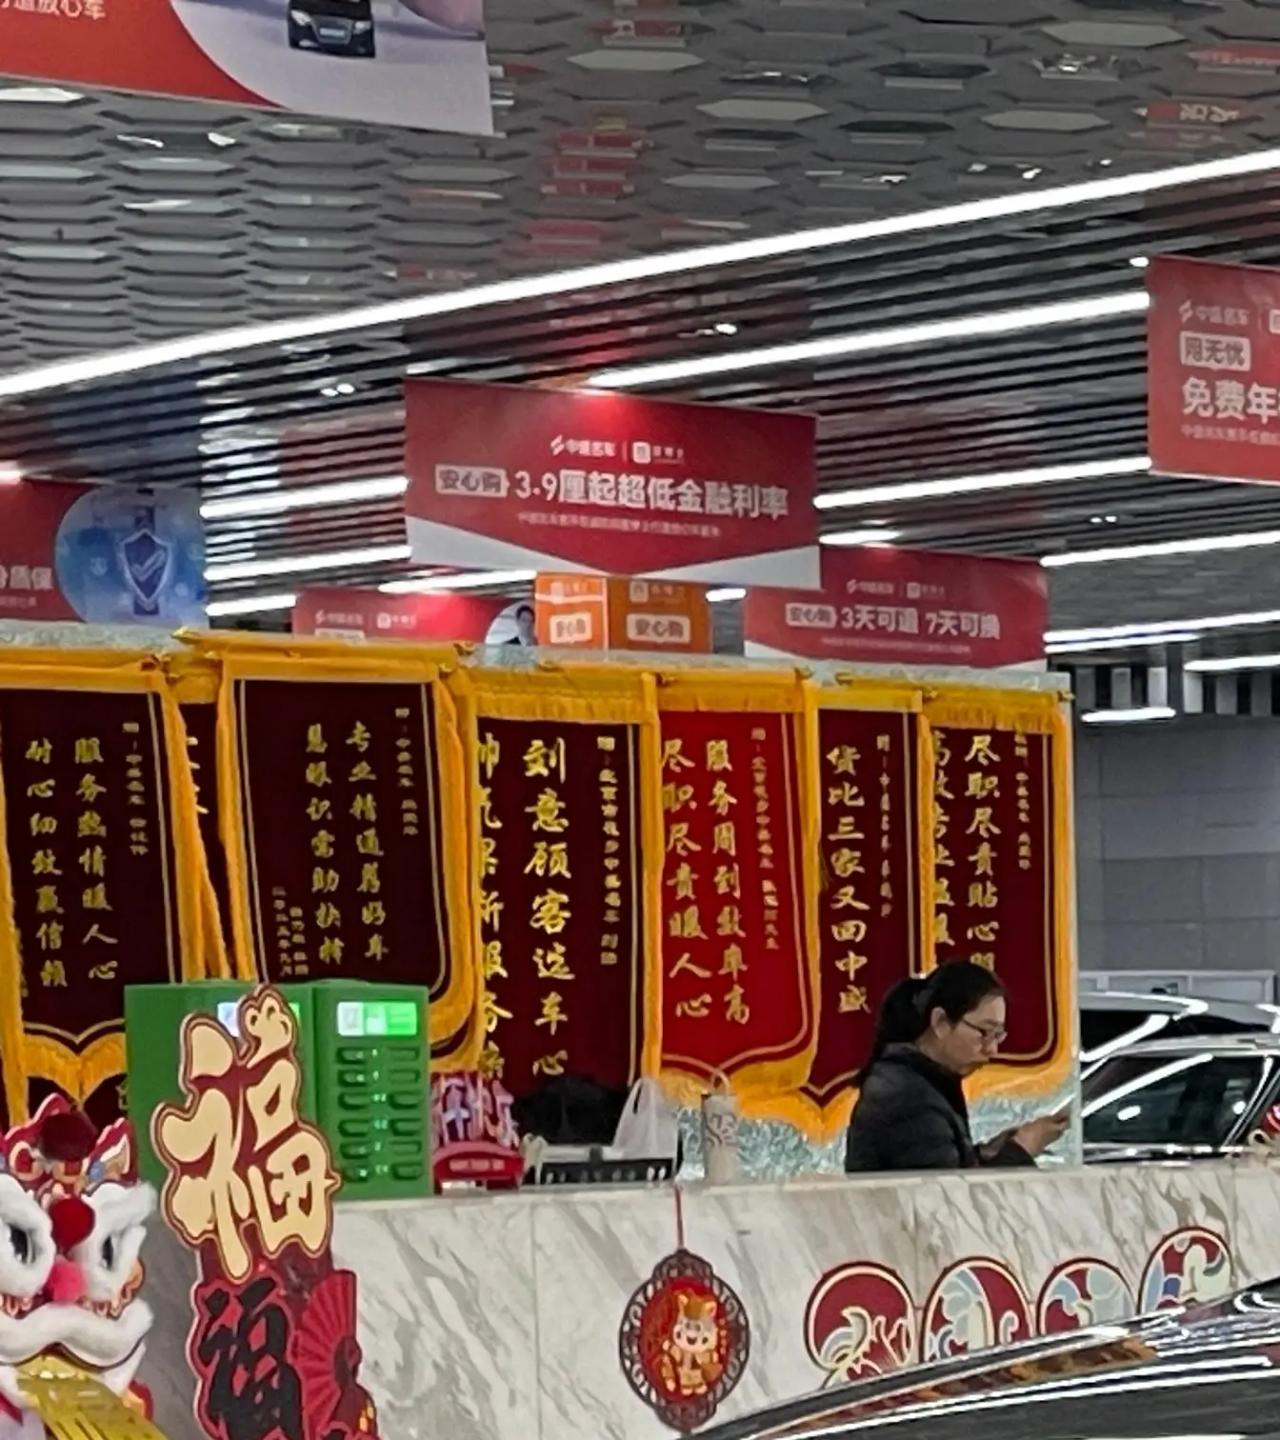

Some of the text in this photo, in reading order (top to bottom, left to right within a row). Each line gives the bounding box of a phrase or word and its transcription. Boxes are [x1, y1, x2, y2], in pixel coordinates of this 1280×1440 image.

[514, 468, 789, 521] 3.9厘起超低金融利率
